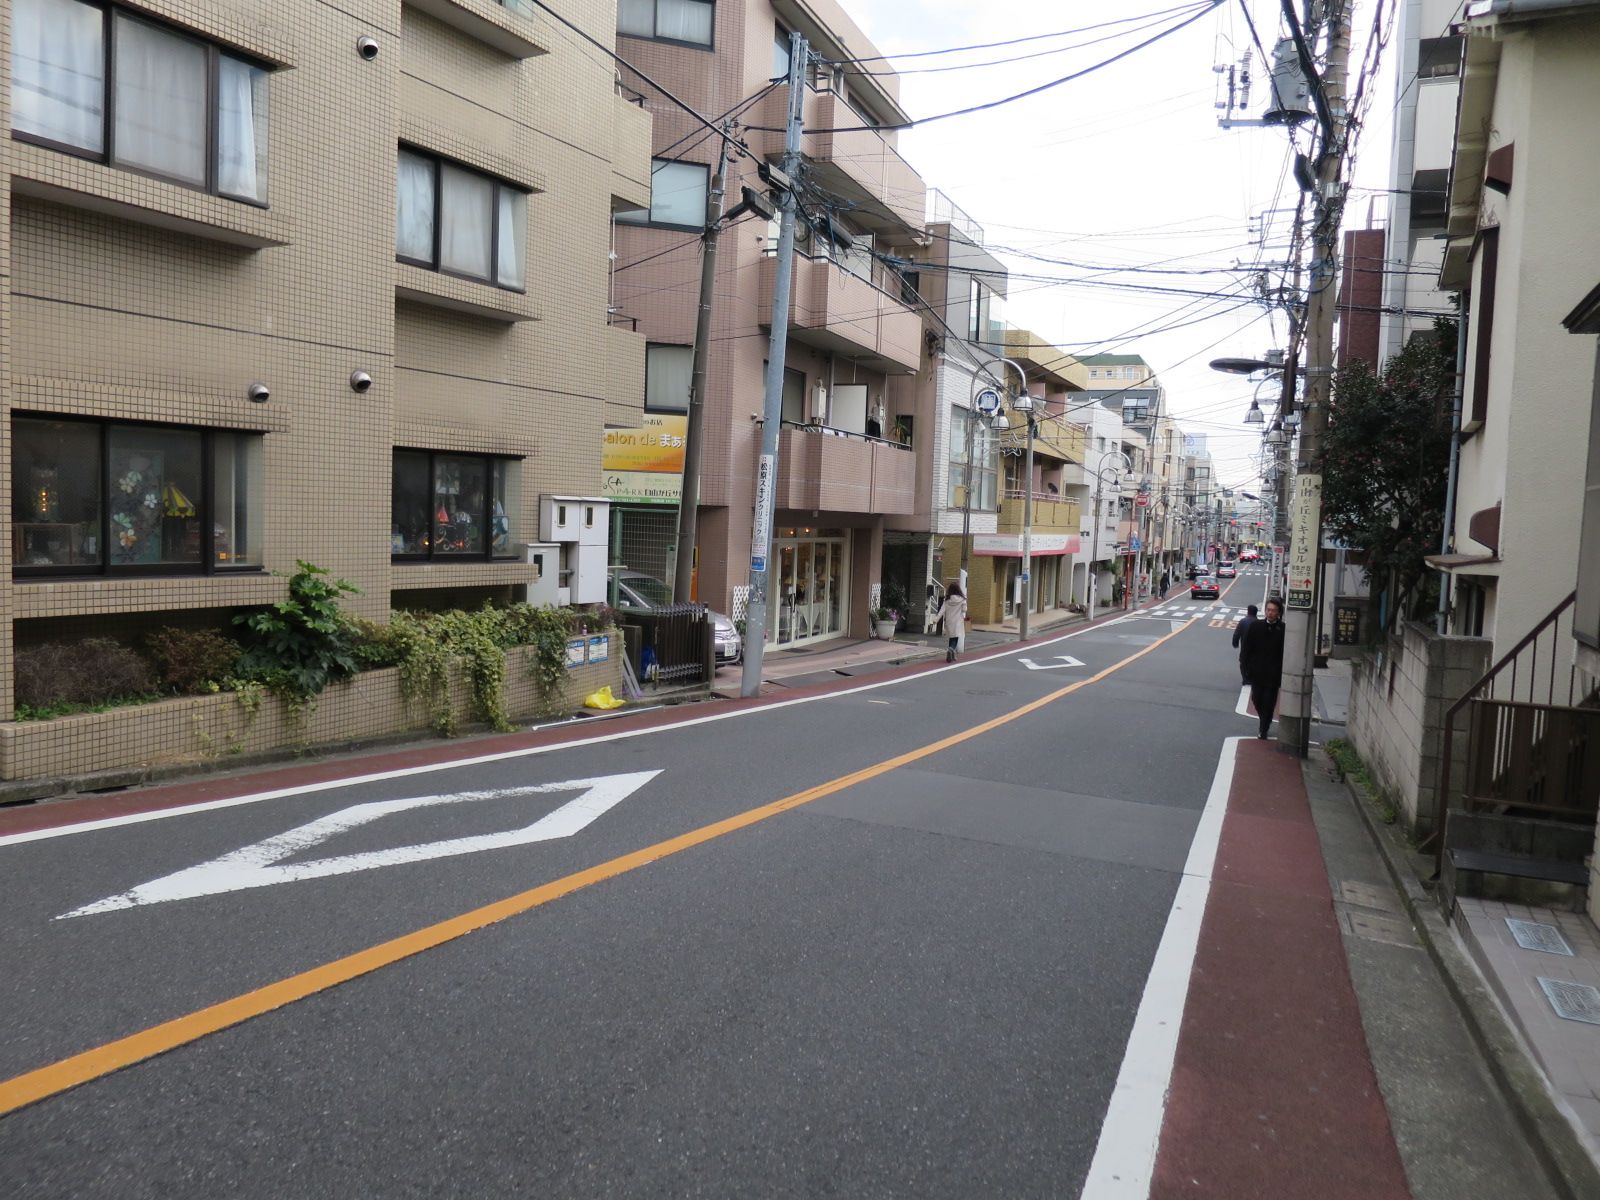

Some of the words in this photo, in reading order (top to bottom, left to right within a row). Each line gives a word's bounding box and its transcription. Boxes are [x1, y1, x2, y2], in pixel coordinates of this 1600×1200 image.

[641, 433, 657, 446] de
[1296, 476, 1313, 563] 自由が丘ミキオビル
